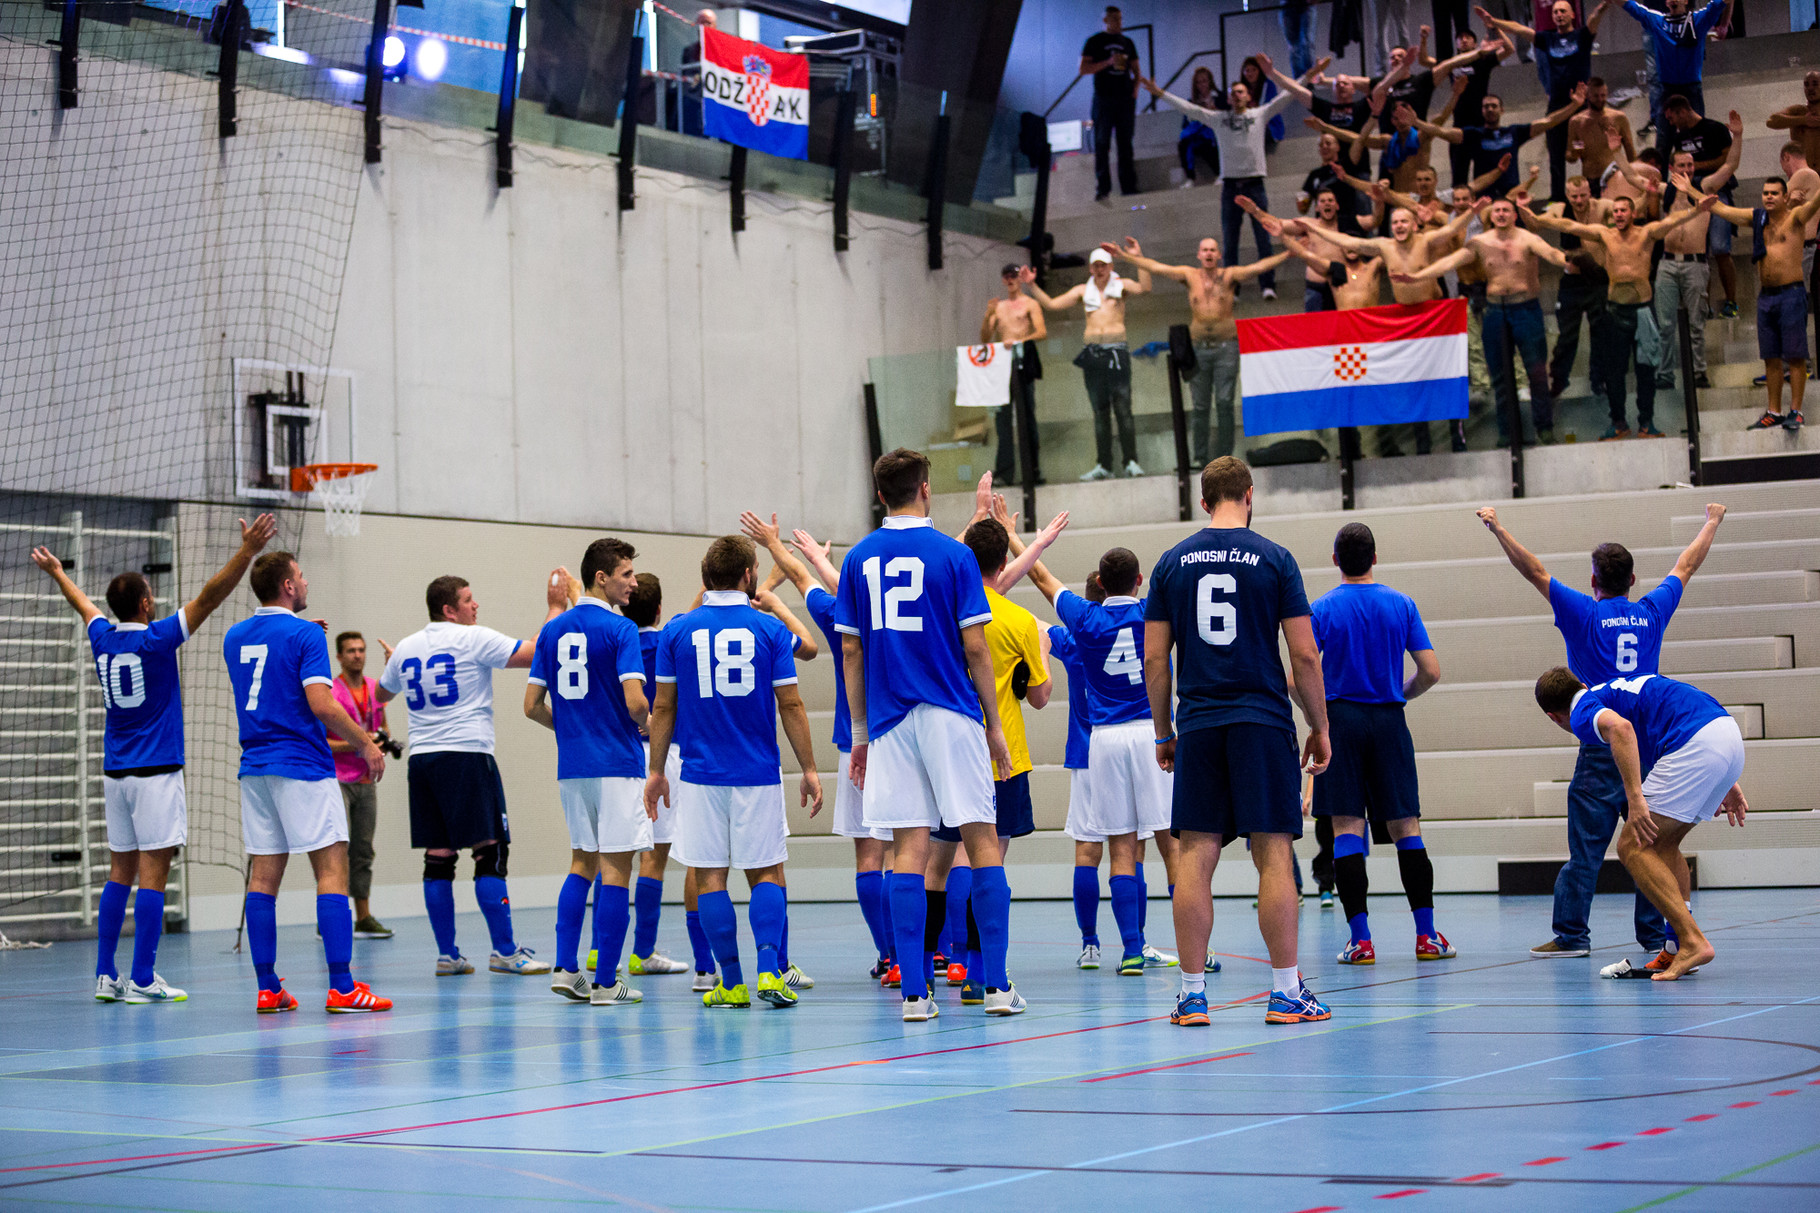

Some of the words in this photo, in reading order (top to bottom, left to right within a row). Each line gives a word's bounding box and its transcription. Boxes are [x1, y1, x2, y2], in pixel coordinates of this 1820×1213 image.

[773, 95, 802, 120] AK
[1180, 550, 1227, 567] PONOSNI
[1229, 547, 1260, 567] ČLAN
[862, 556, 925, 632] 12
[1197, 573, 1237, 646] 6
[1601, 616, 1630, 629] PONOSNI
[1630, 615, 1649, 627] ČLAN
[97, 652, 146, 709] 10
[240, 644, 269, 711] 7
[401, 652, 459, 711] 33
[557, 632, 589, 700] 8
[691, 628, 756, 699] 18
[1103, 627, 1143, 685] 4
[1616, 633, 1638, 672] 6
